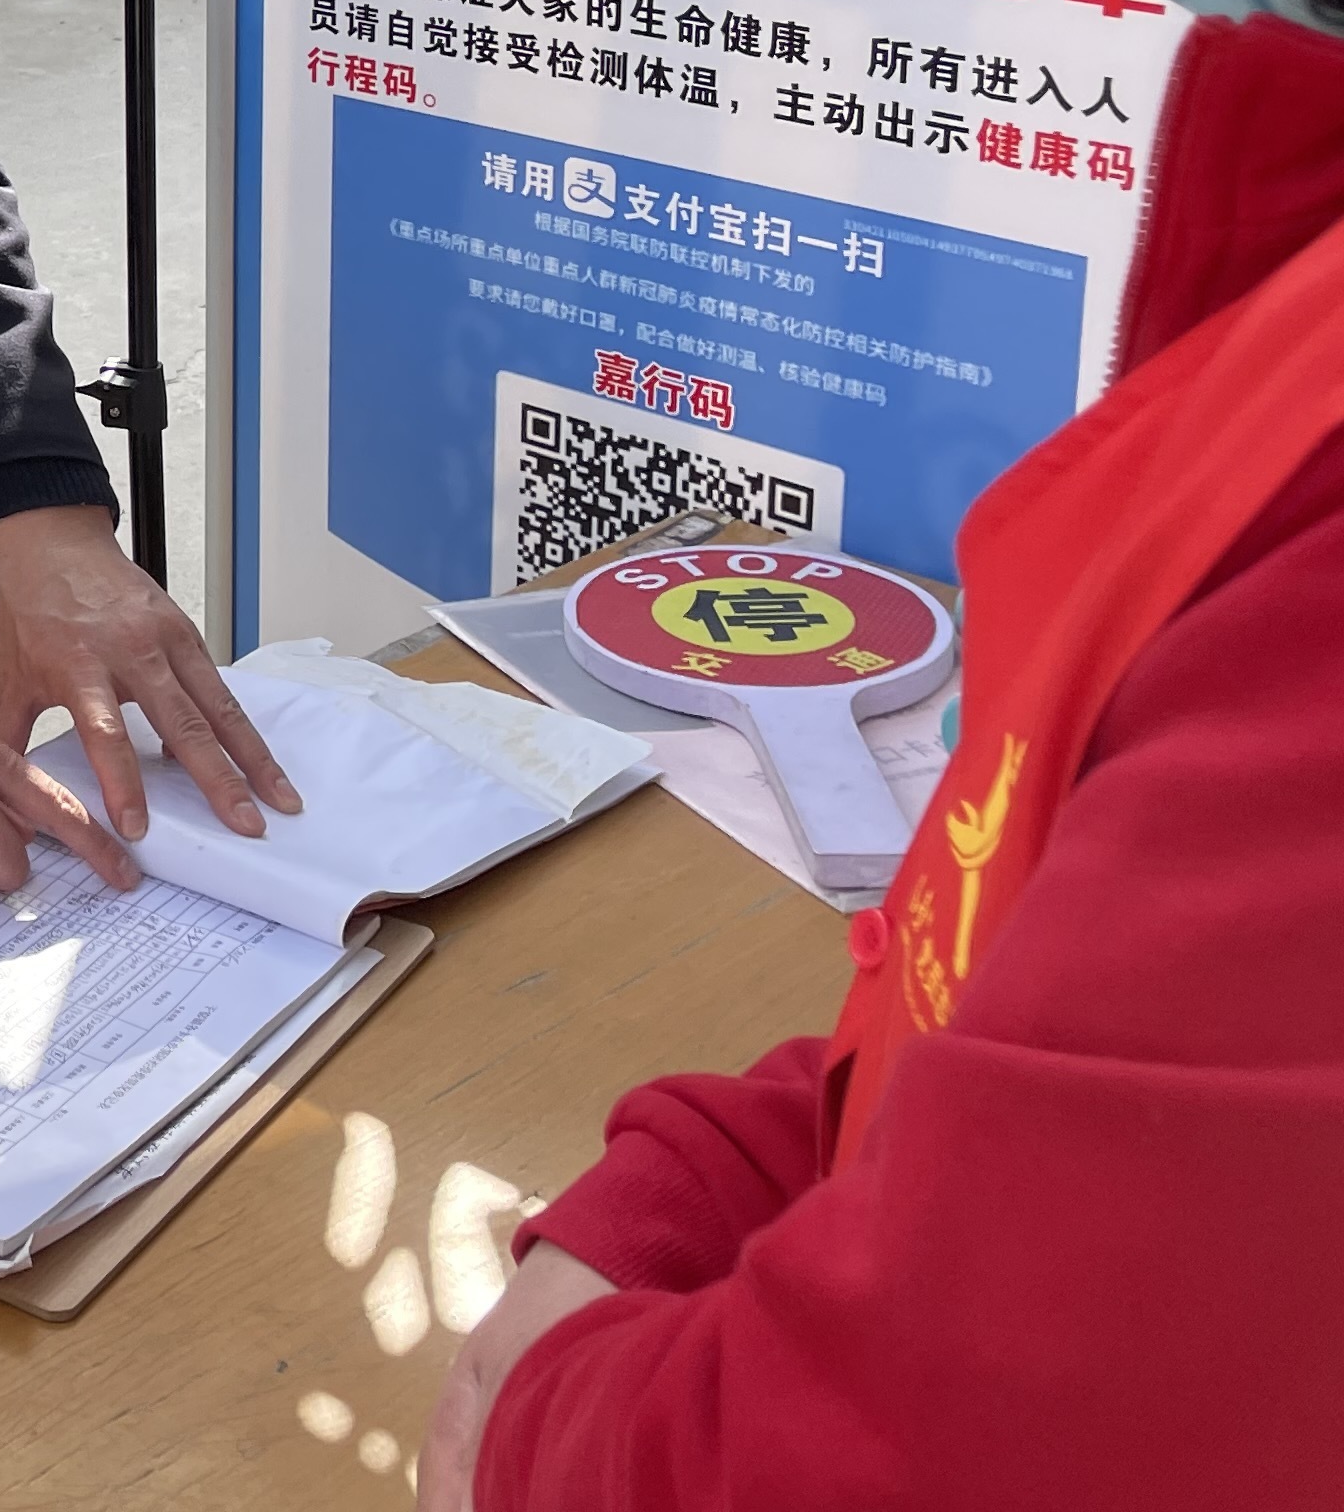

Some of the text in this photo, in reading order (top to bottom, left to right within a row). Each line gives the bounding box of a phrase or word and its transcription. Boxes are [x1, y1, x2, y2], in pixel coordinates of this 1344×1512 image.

[534, 210, 815, 296] 根据国务院联防联控机制下发的
[594, 348, 735, 431] 嘉行码
[615, 553, 843, 590] STOP
[683, 588, 828, 643] 停
